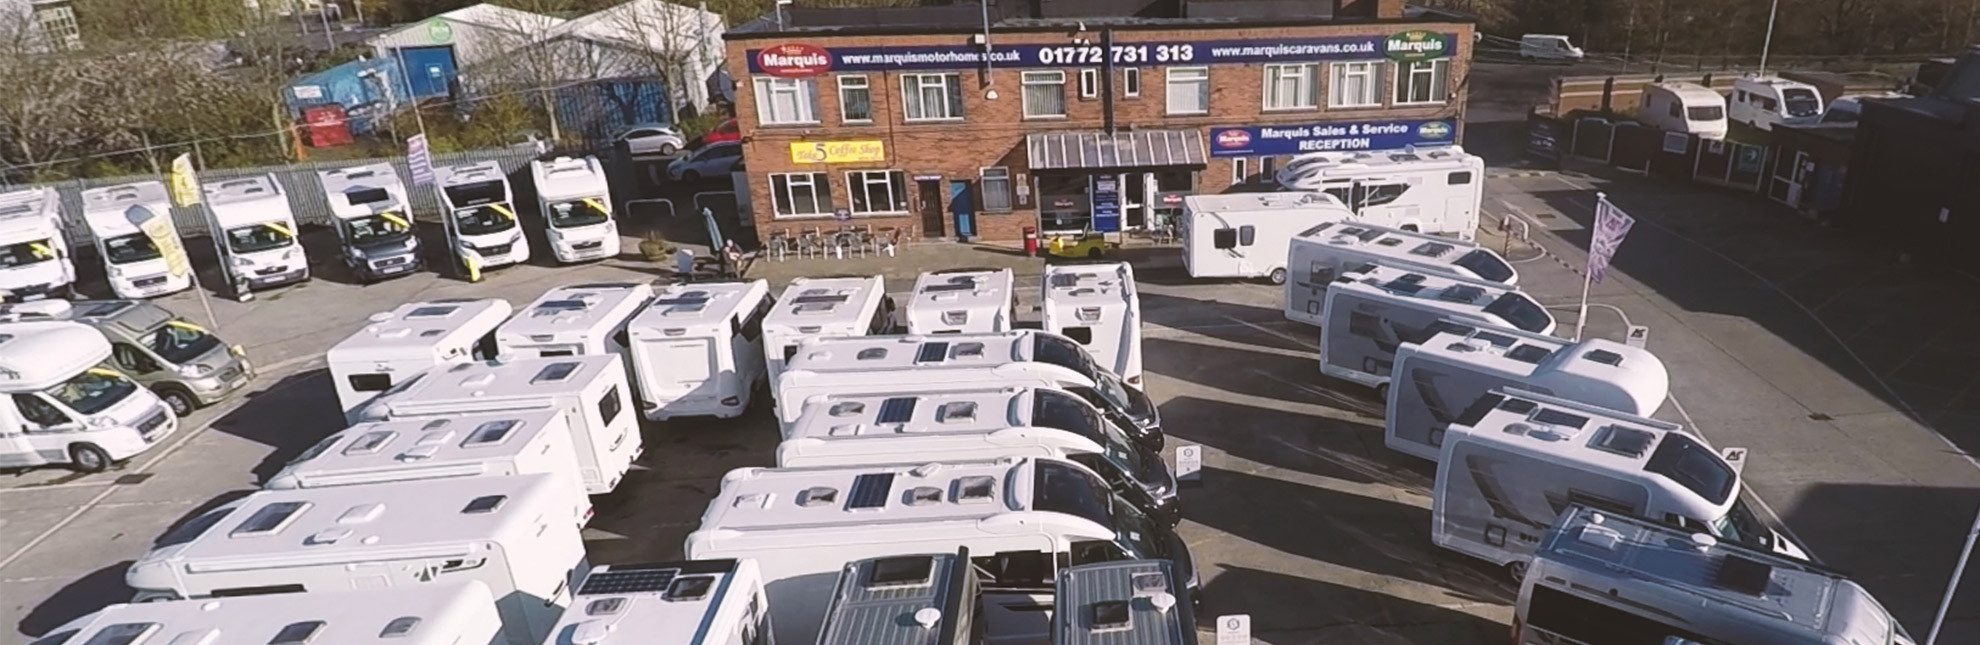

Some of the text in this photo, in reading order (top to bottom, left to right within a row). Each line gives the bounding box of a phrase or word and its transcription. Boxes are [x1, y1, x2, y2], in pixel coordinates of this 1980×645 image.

[842, 41, 1374, 65] www.marquismotorhomsco.uk 01772 731 313 www.marquiscaravans.co.uk
[1388, 39, 1442, 53] Marquis
[763, 53, 827, 68] Marquis
[1218, 135, 1250, 143] Marquis
[1261, 124, 1408, 139] Marquis Sales & Service
[815, 143, 827, 161] 5
[1299, 138, 1370, 151] RECEPTION
